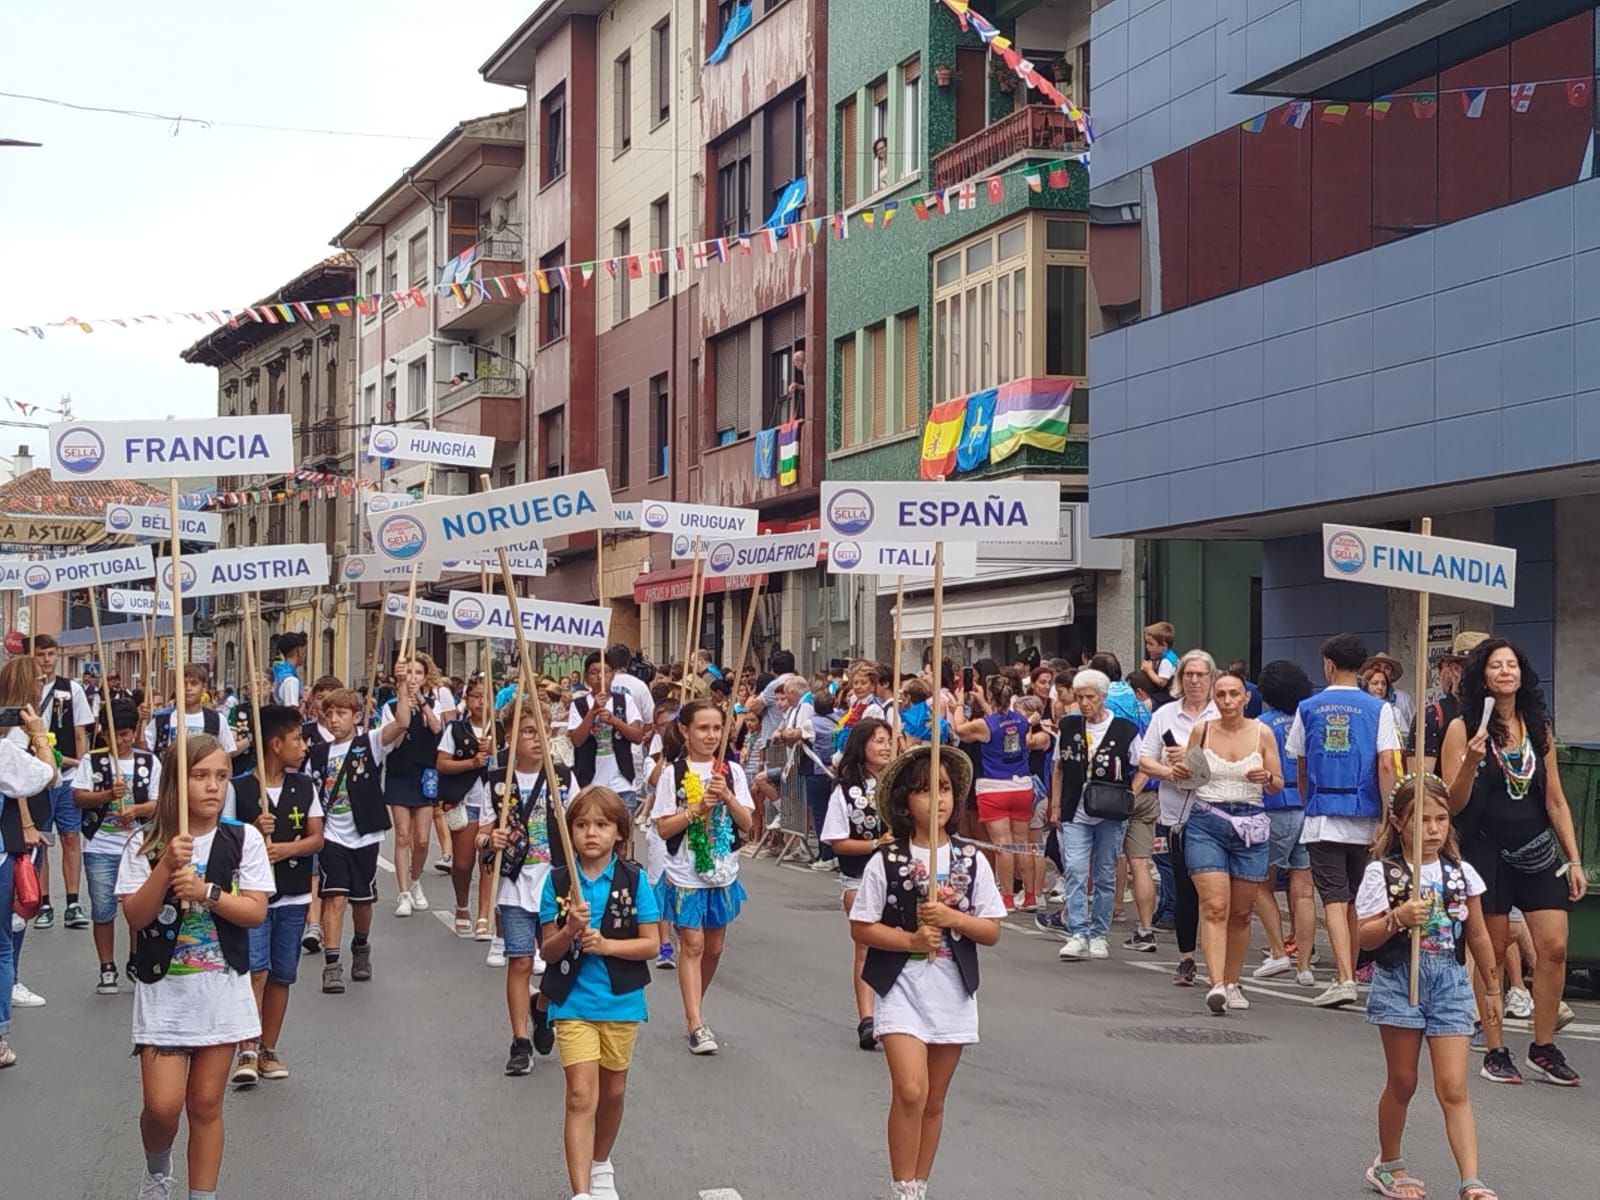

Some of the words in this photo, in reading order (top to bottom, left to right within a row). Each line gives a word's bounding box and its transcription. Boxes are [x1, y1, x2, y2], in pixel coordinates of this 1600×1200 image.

[64, 448, 97, 457] SELLA
[125, 434, 270, 463] FRANCIA
[410, 438, 476, 458] HUNGRÍA
[441, 489, 597, 540] NORUEGA
[834, 510, 866, 519] SELLA
[898, 495, 1028, 527] ESPAÑA
[0, 524, 16, 538] A
[141, 514, 207, 534] BÉLICA
[680, 513, 746, 531] URUGUAY
[386, 533, 420, 547] SELLA
[690, 541, 709, 554] RIN
[736, 542, 815, 565] SUDÁFRICA
[1335, 550, 1361, 560] SELLA
[55, 557, 147, 582] PORTUGAL
[211, 558, 311, 585] AUSTRIA
[464, 559, 544, 569] VENEUELA
[1372, 545, 1508, 589] FINLANDIA
[487, 608, 606, 638] ALEMANIA
